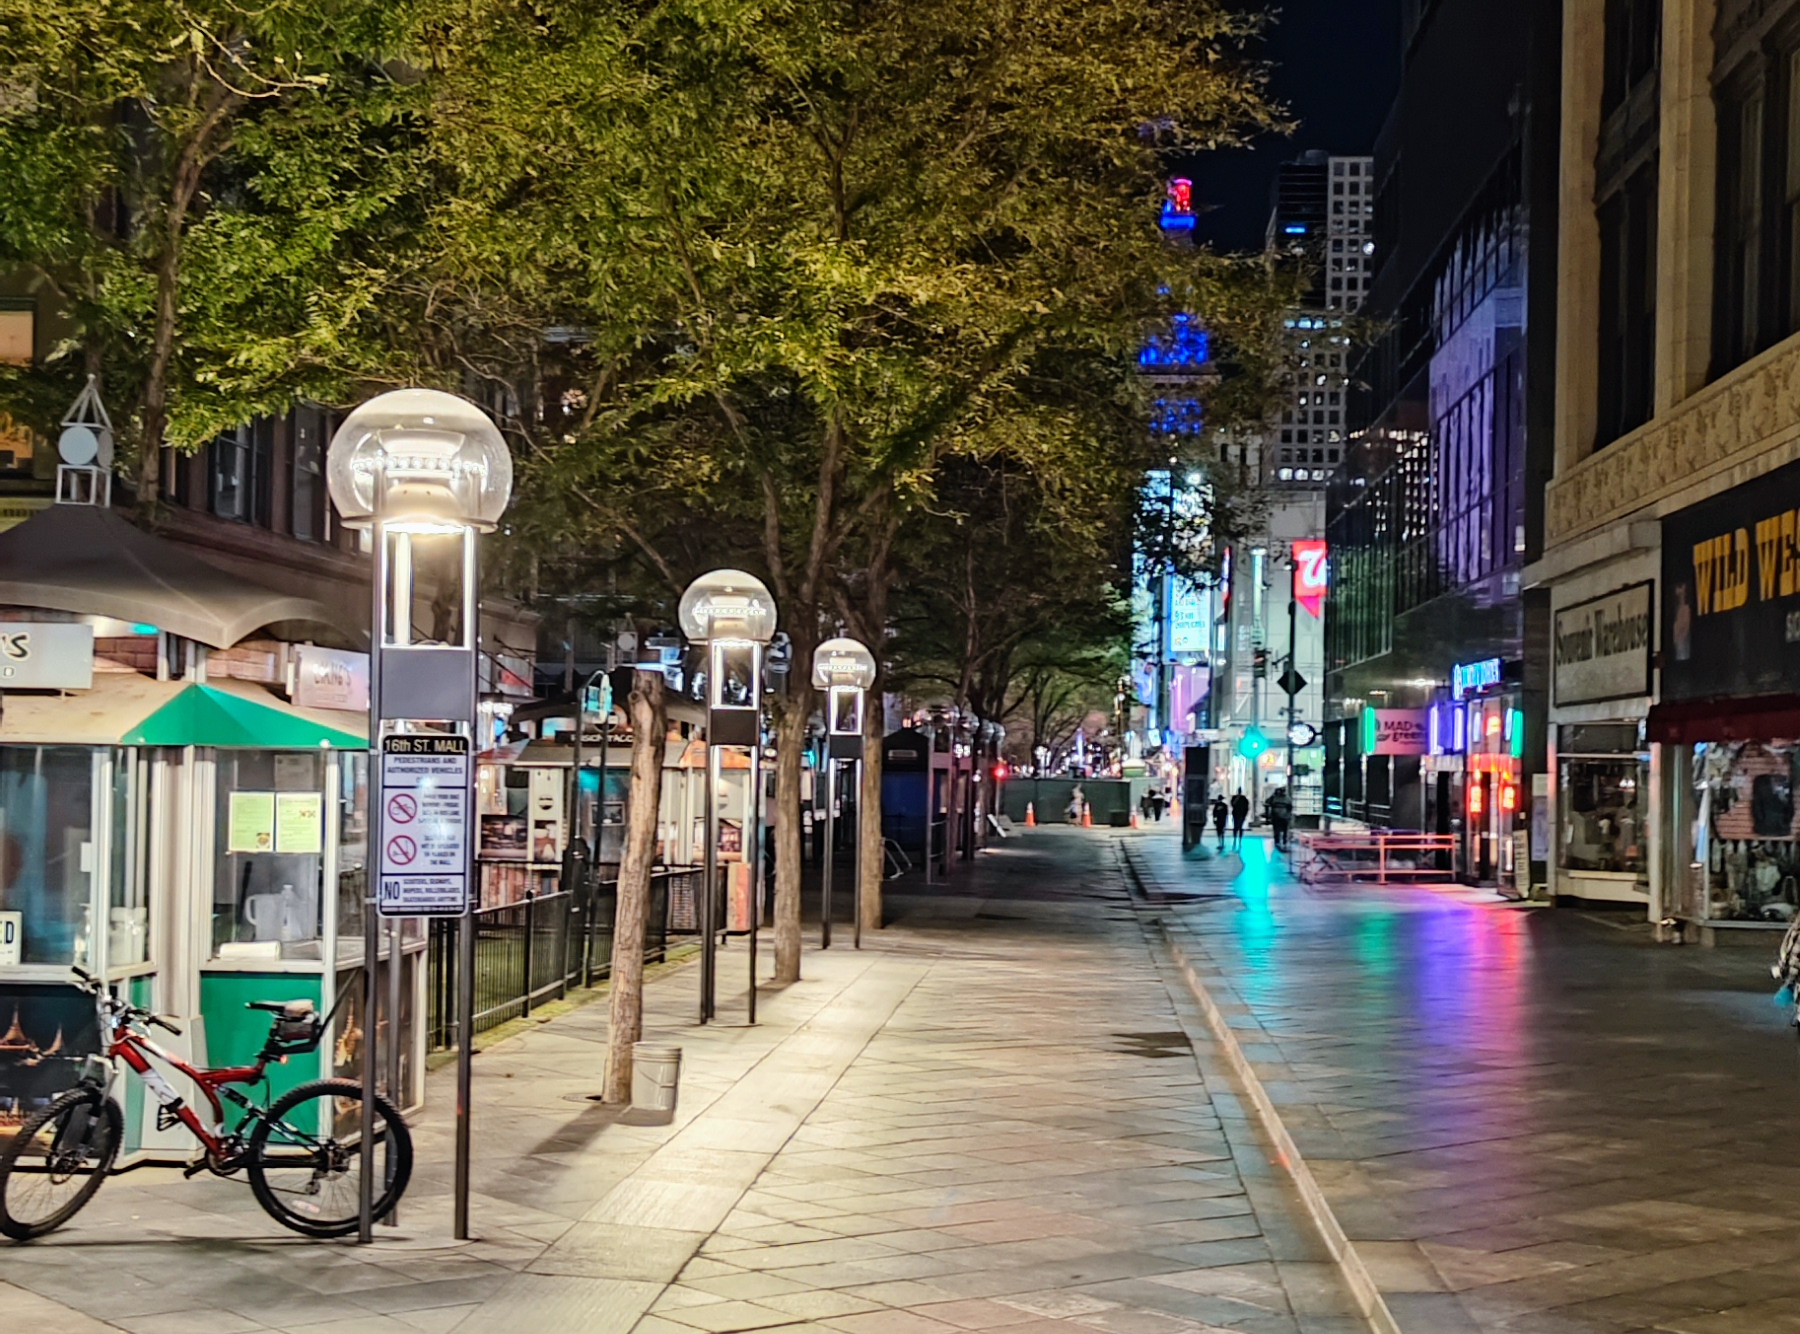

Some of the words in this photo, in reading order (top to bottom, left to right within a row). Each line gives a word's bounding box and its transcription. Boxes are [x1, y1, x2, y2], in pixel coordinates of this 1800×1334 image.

[1693, 528, 1749, 616] WILD
[1557, 612, 1593, 666] Souvenir
[1594, 602, 1648, 658] Warehouse
[1384, 721, 1412, 731] MAD
[385, 739, 411, 752] 16th
[413, 739, 432, 752] ST.
[434, 739, 465, 753] MALL
[431, 767, 463, 775] VEHICLES
[384, 881, 400, 900] NO
